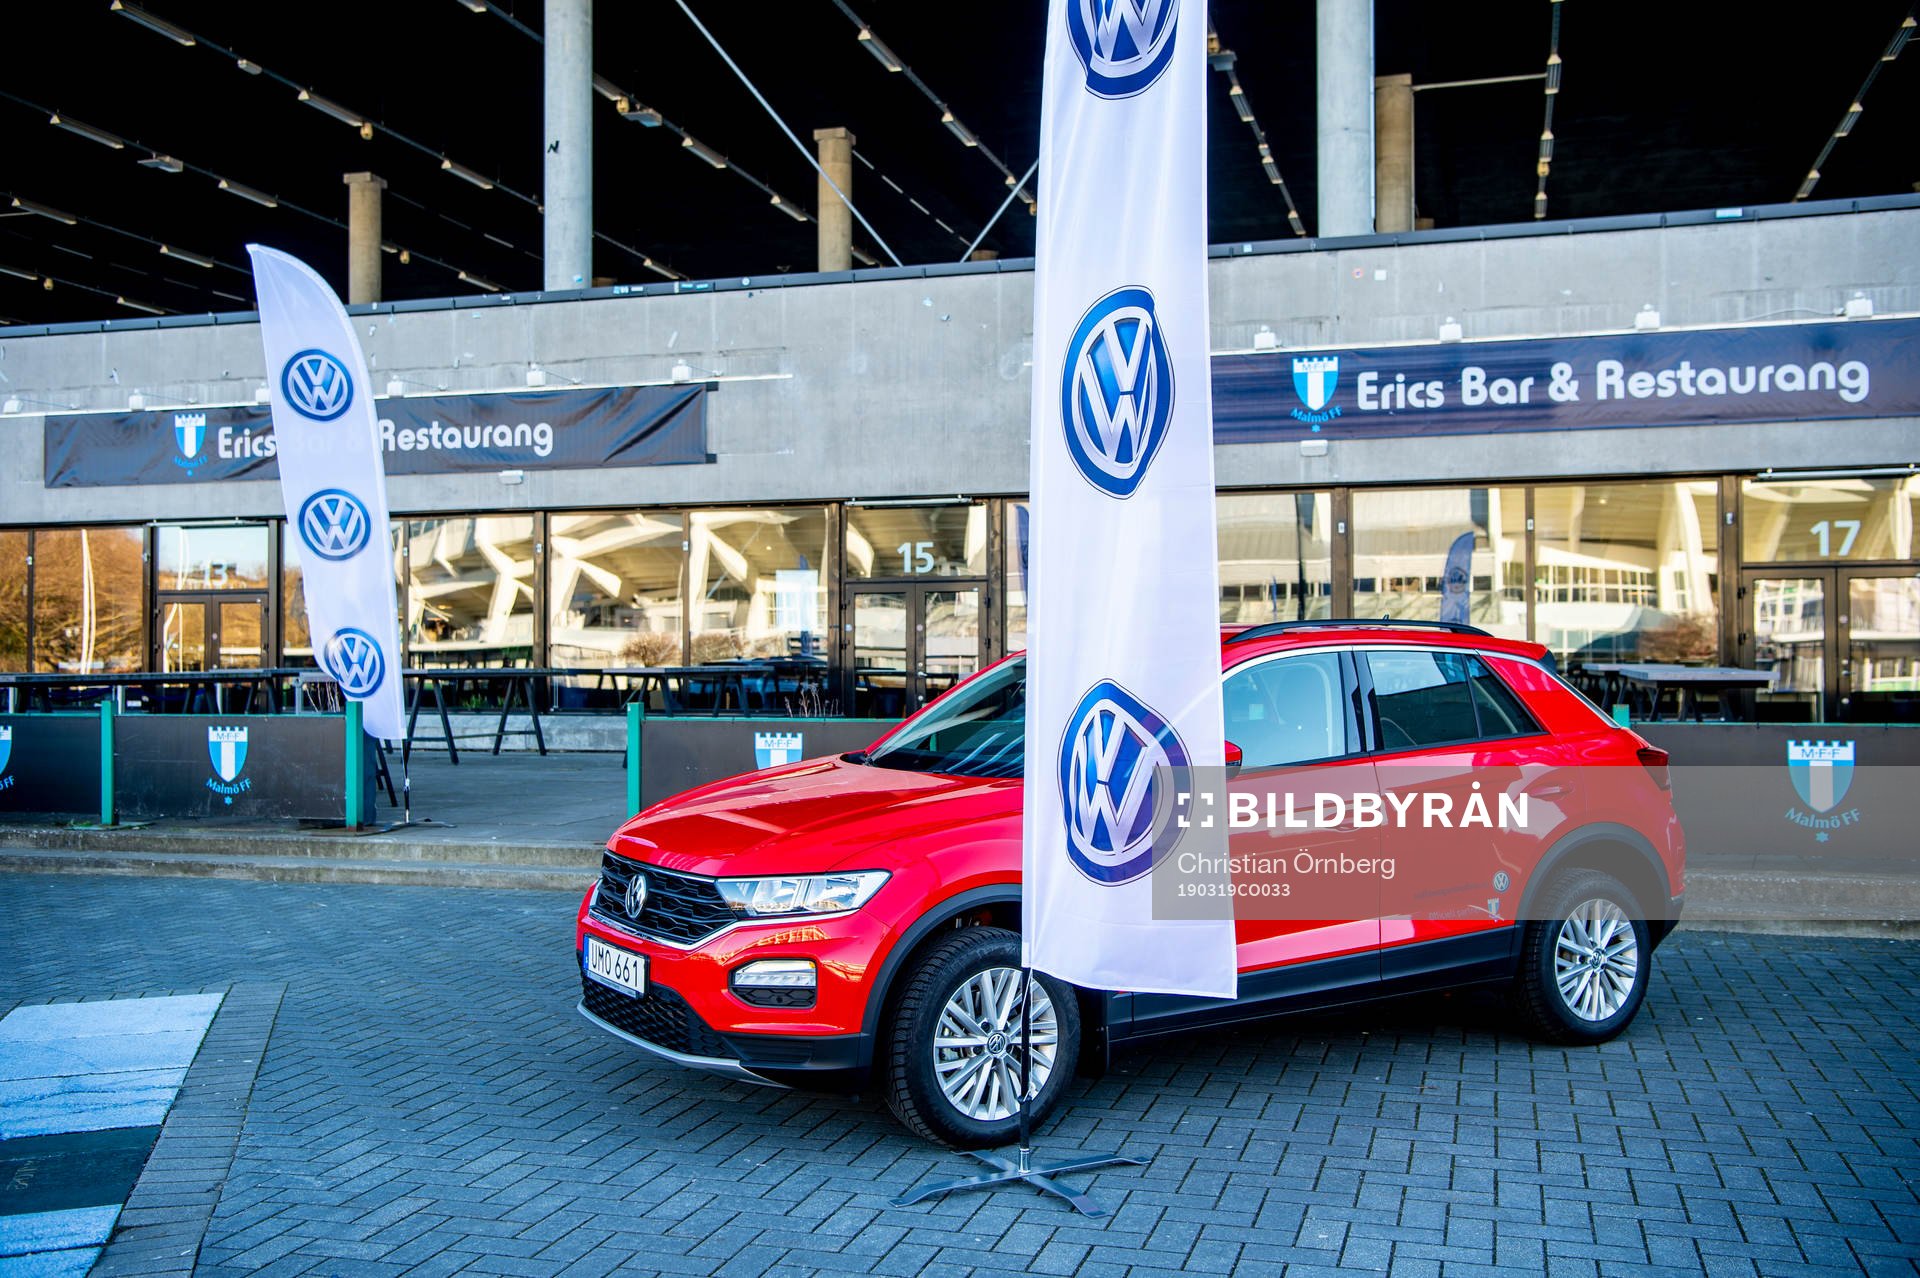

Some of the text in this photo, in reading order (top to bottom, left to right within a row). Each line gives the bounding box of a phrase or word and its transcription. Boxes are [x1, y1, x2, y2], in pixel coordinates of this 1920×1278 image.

[1357, 359, 1870, 410] Erics Bar & Restaurang
[217, 426, 277, 459] Erics
[378, 418, 553, 457] Restaurang
[1809, 520, 1861, 557] 17
[897, 541, 935, 574] 15
[206, 777, 252, 795] Malmö FF
[1785, 808, 1860, 828] Malmö FF
[614, 953, 638, 988] 661
